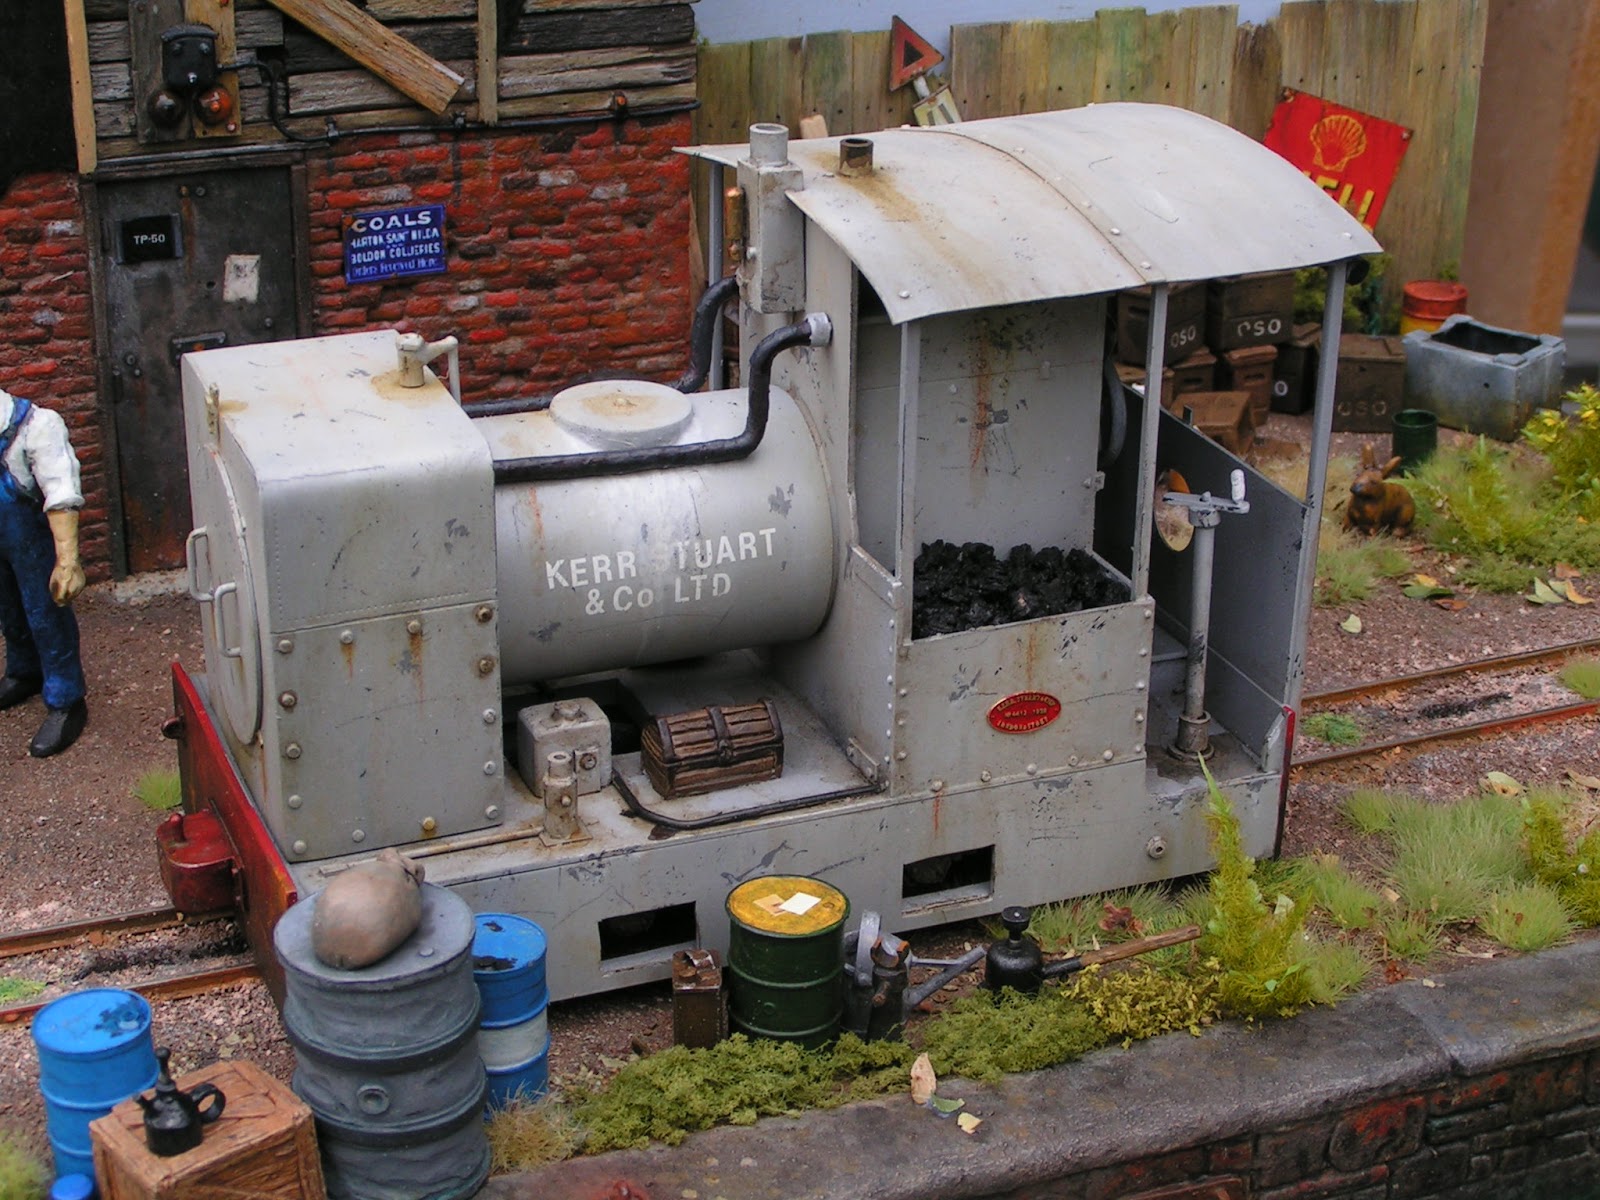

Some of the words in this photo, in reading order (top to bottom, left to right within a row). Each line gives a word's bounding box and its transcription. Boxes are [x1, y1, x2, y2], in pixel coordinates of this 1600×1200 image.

[351, 210, 432, 233] COALS
[133, 233, 166, 245] TP-50
[545, 550, 637, 590] KERR
[673, 572, 732, 604] LTD
